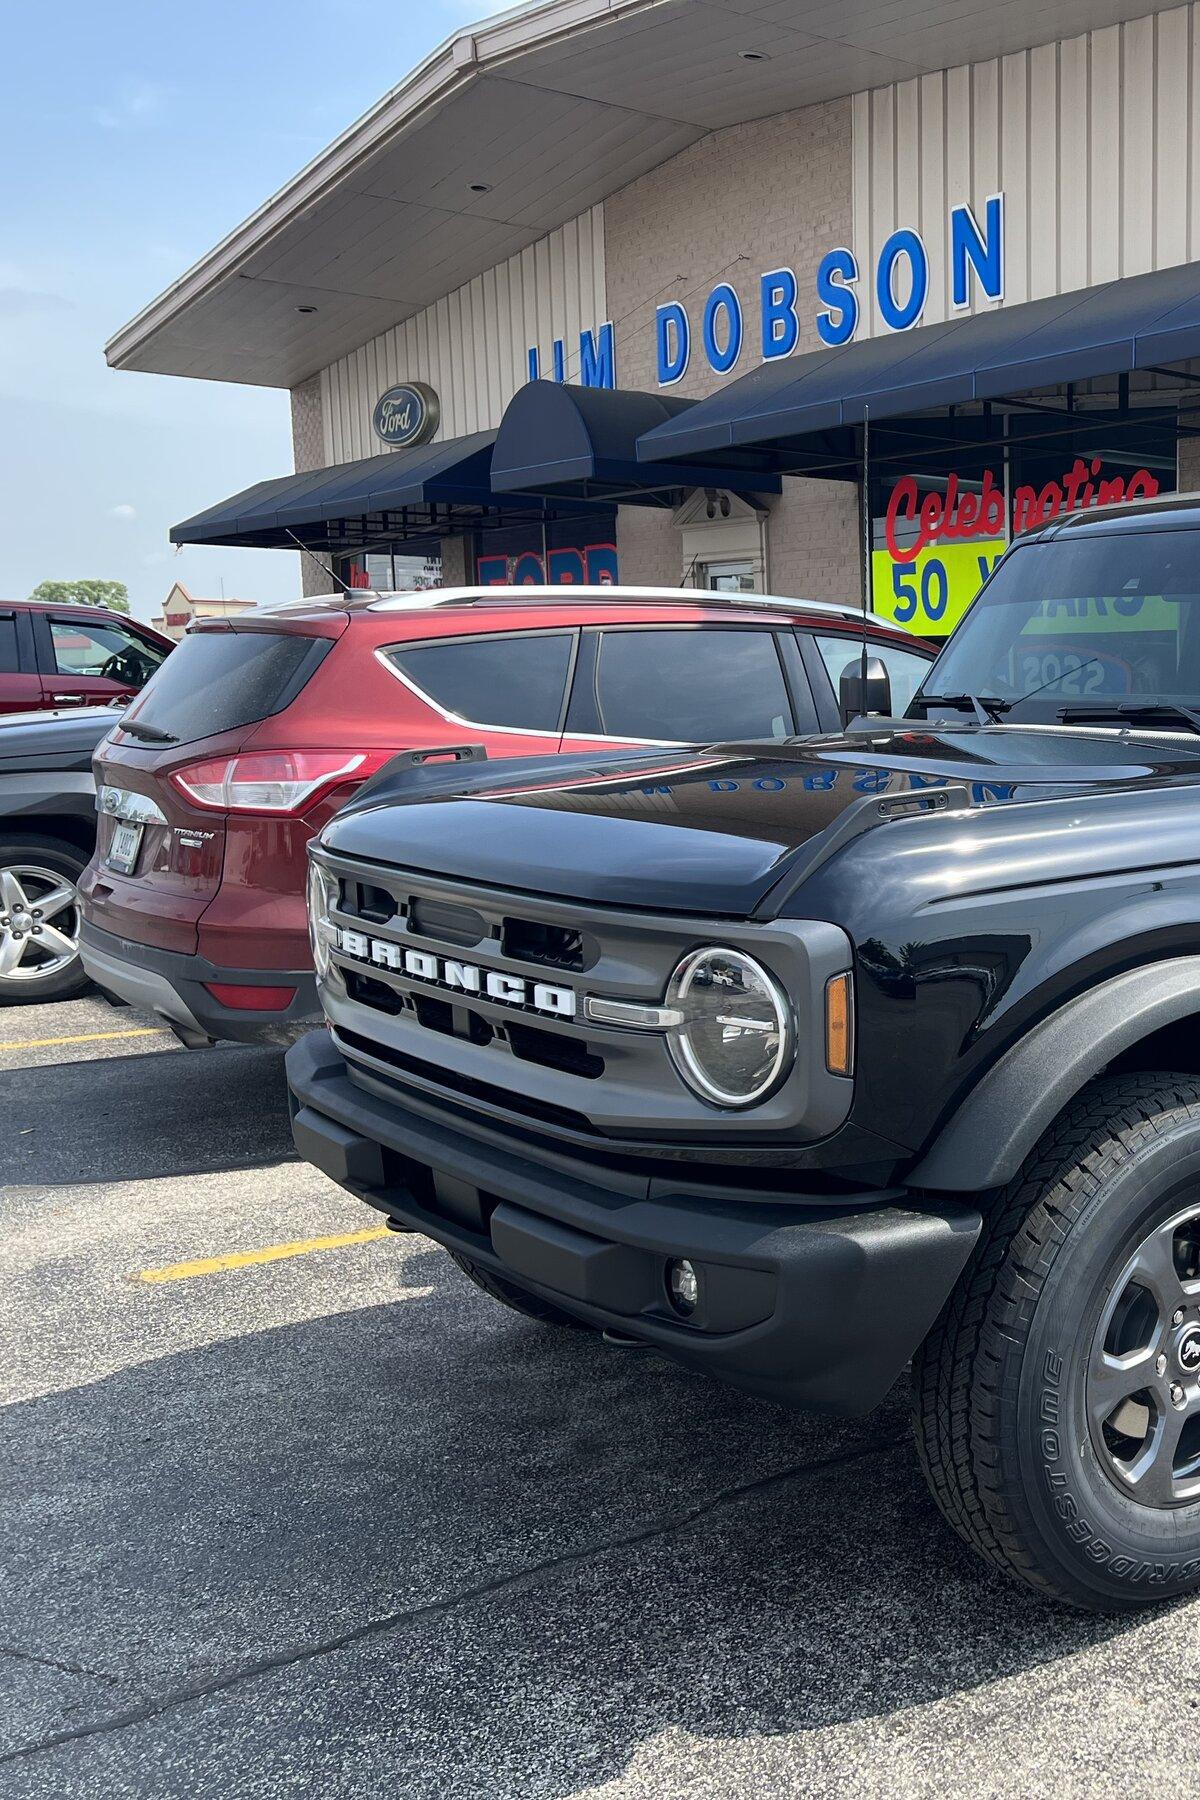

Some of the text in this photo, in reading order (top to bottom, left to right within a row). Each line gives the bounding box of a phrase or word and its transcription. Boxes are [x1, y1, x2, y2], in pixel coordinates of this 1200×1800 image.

[656, 191, 1004, 388] DOBSON
[380, 398, 411, 435] Ford
[892, 558, 948, 622] 50
[1022, 654, 1105, 695] 2022
[173, 828, 215, 840] TITANIUM
[342, 929, 577, 1017] BRONCO
